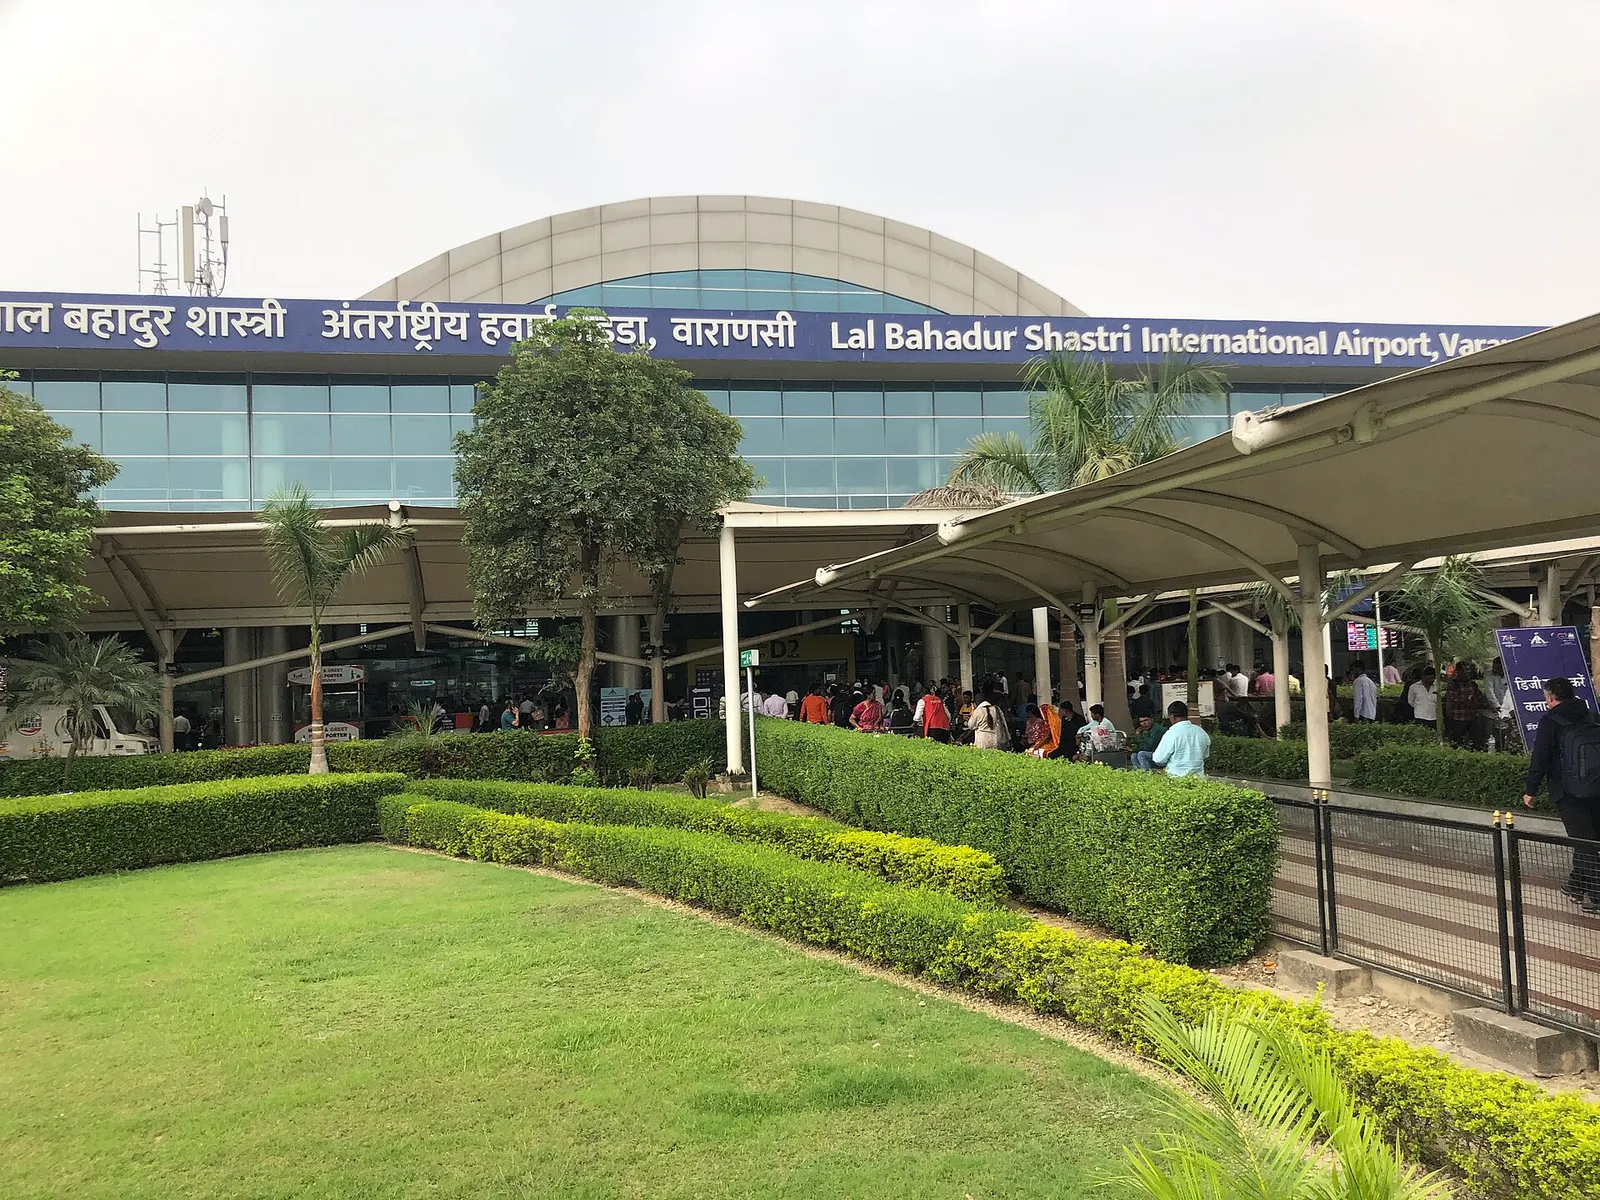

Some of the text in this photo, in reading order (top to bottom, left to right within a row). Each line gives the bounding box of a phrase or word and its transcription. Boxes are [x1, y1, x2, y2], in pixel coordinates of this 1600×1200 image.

[61, 303, 176, 348] बहादुर
[186, 298, 287, 338] शास्त्री
[321, 301, 470, 351] अंतर्राष्ट्रीय
[478, 304, 557, 347] हवा
[670, 310, 797, 348] वाराणसी
[831, 319, 875, 350] Lal
[885, 320, 1018, 351] Bahadur
[1024, 322, 1132, 352] Shastri
[1141, 325, 1327, 356] International
[1514, 675, 1541, 690] डिजी
